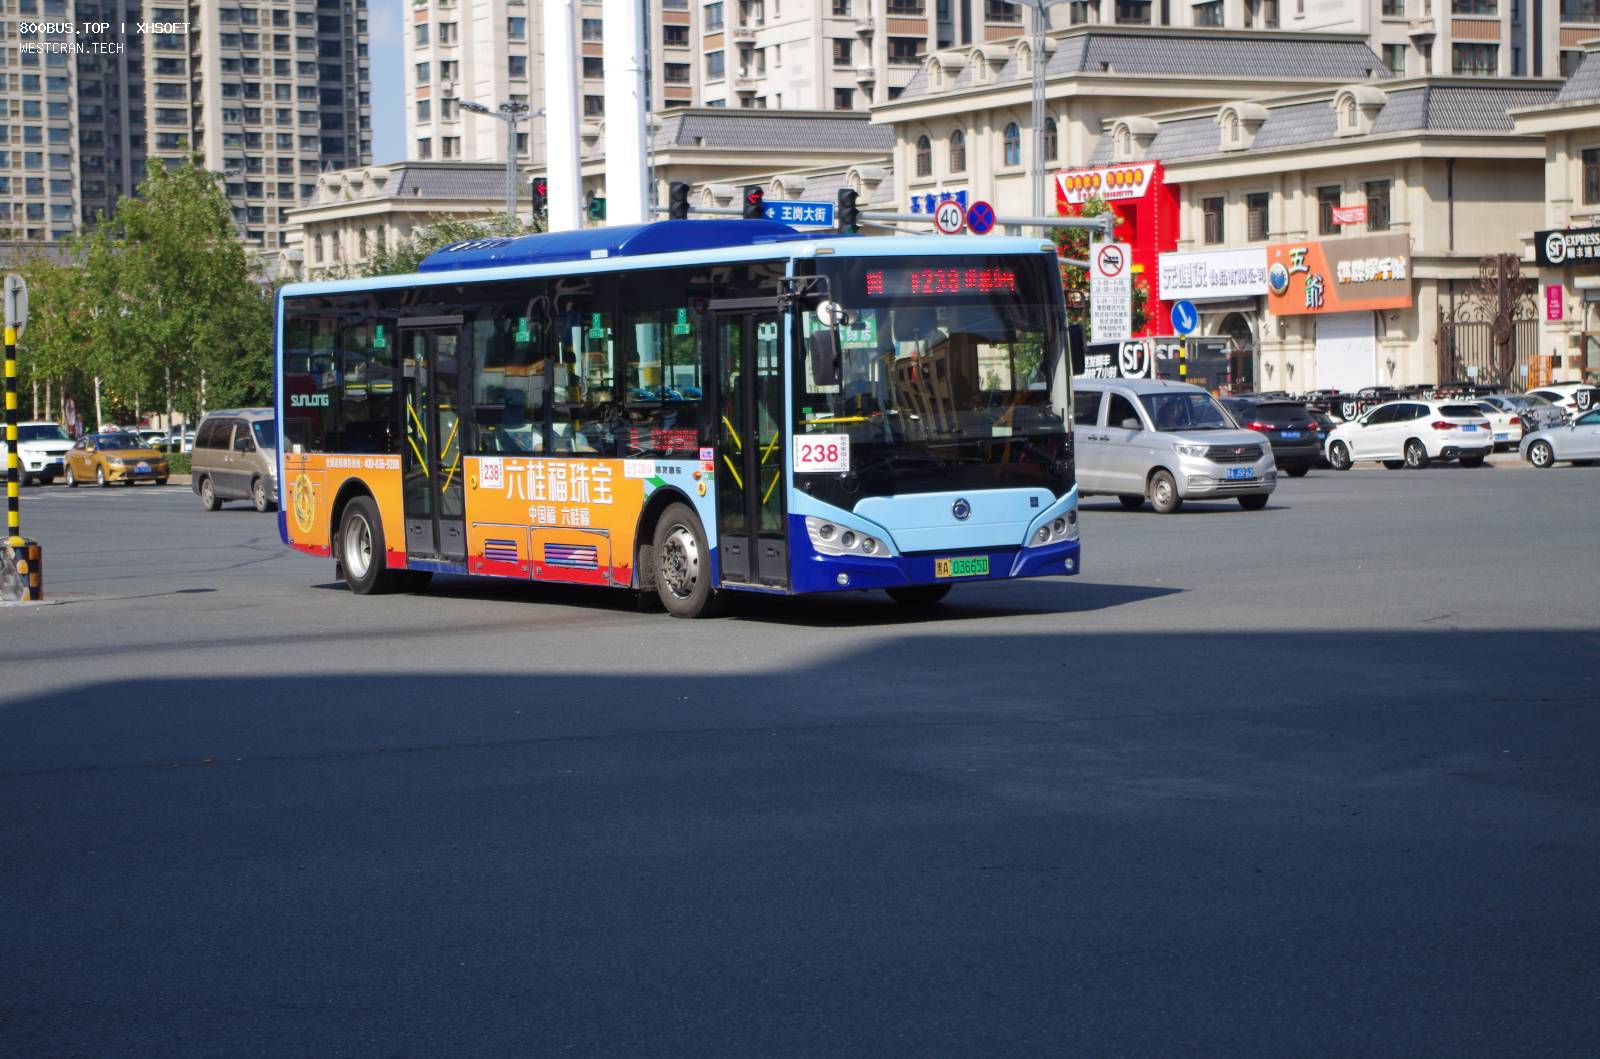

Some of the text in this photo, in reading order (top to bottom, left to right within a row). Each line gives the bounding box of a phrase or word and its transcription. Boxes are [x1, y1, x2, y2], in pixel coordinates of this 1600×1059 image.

[781, 206, 827, 222] 王岗大街
[940, 209, 959, 227] 40
[1565, 232, 1600, 246] EXPRESS
[1208, 264, 1266, 287] 食品有限公司
[290, 394, 329, 407] SUNLONG
[801, 444, 839, 462] 238
[484, 464, 499, 481] 238
[504, 459, 613, 504] 六桂福珠宝
